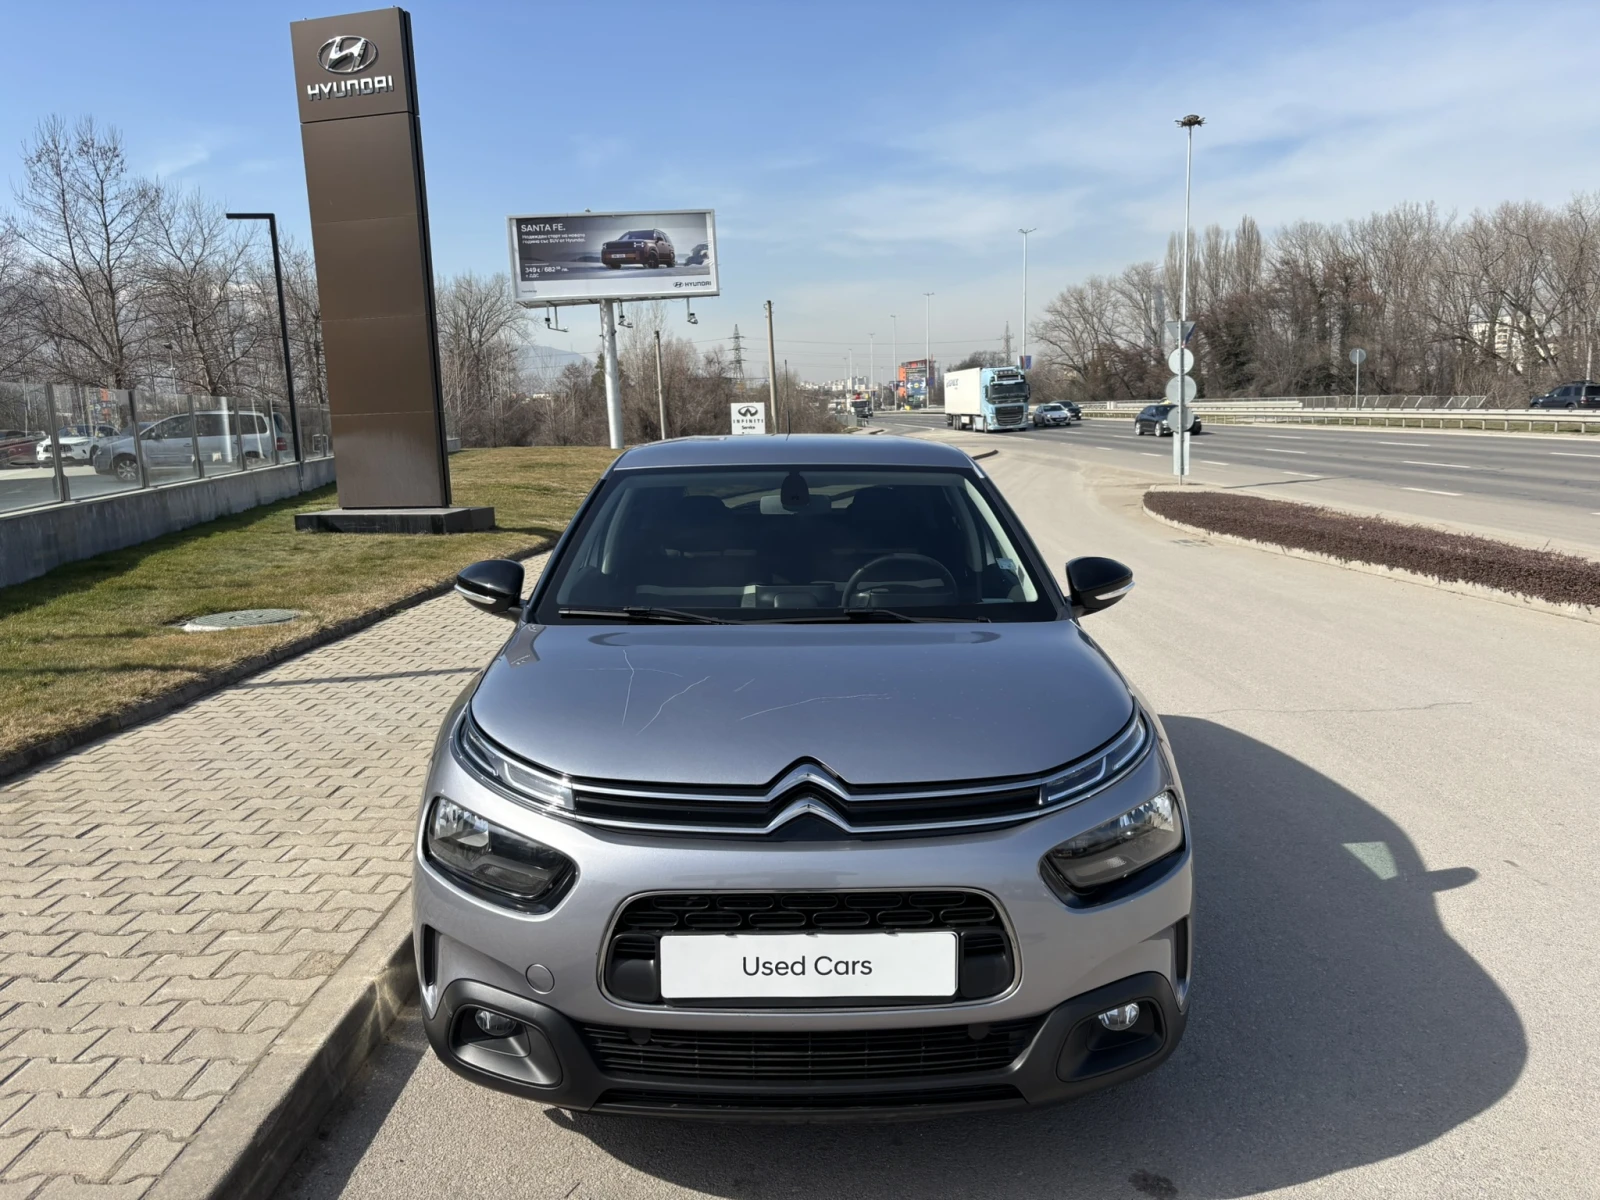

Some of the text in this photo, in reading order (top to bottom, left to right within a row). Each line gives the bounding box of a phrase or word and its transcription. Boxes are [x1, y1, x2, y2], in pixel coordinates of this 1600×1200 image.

[307, 74, 394, 101] HYUNDAI
[521, 223, 566, 232] SANTA FE.
[742, 956, 873, 976] Used Cars
